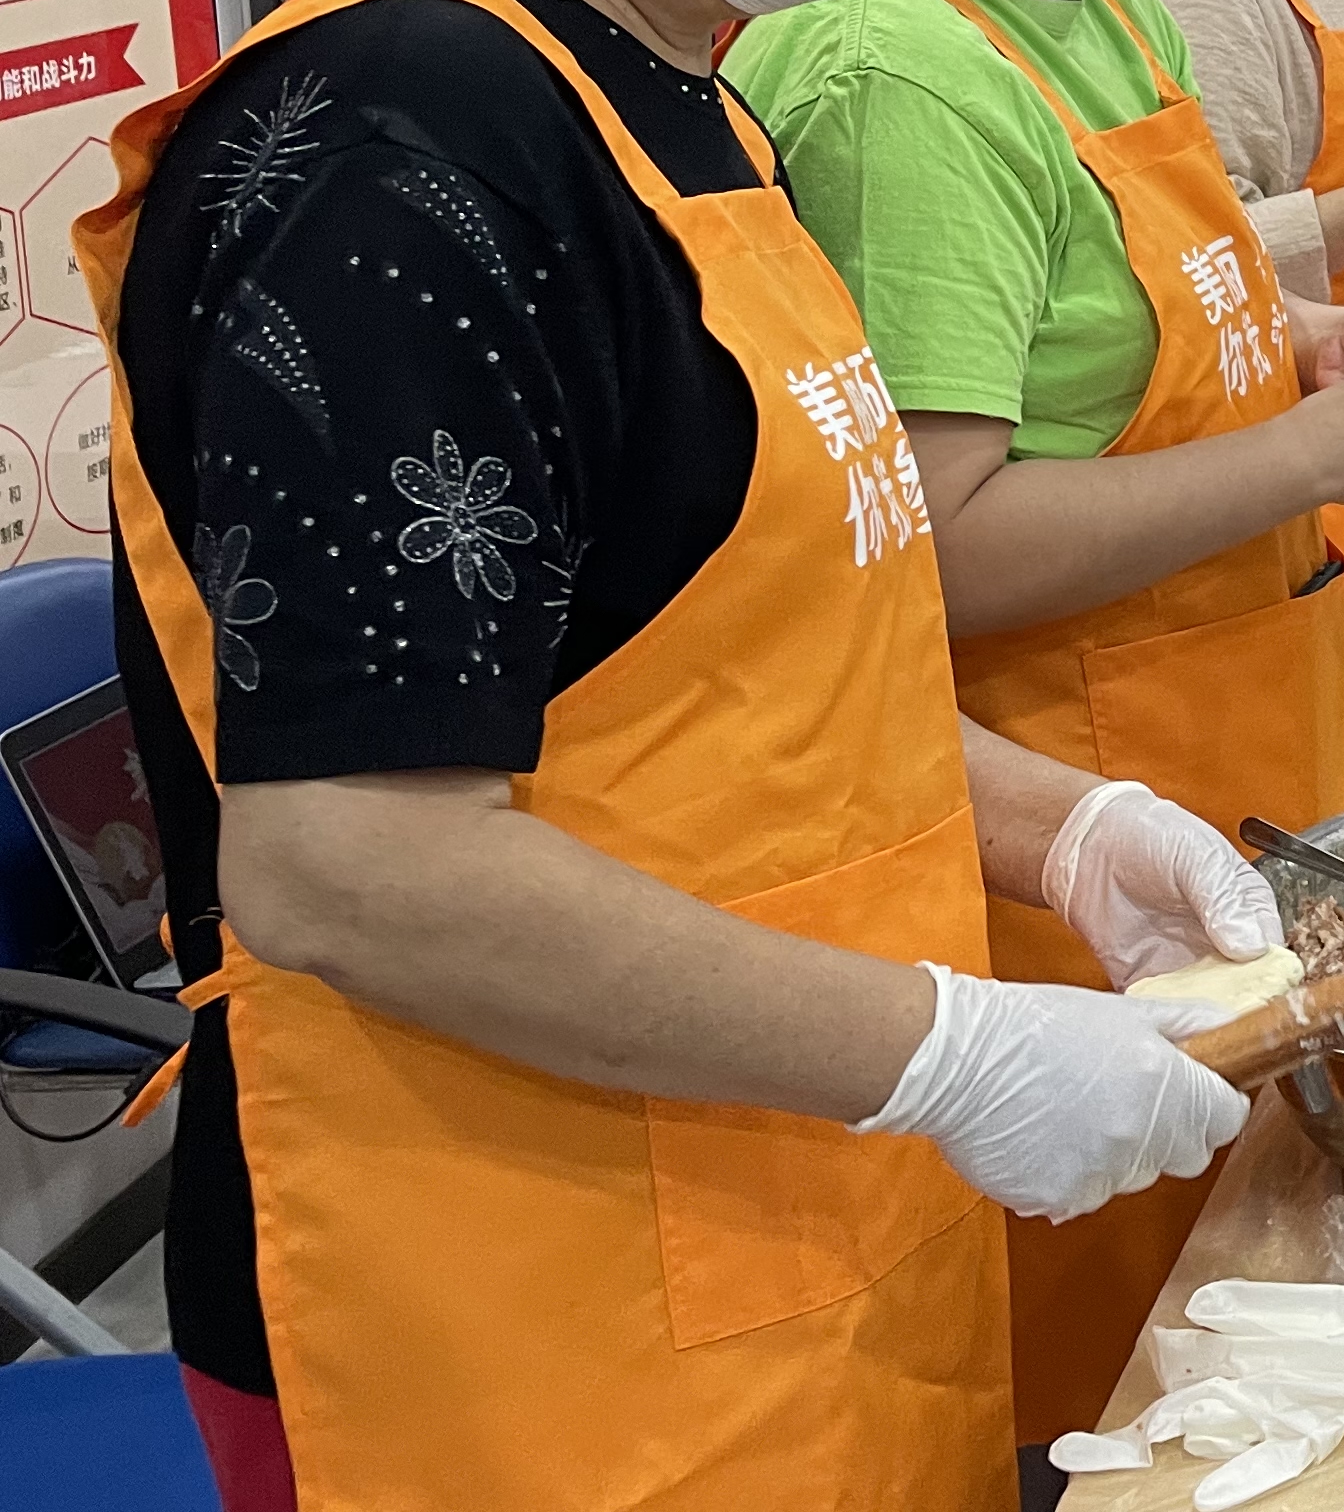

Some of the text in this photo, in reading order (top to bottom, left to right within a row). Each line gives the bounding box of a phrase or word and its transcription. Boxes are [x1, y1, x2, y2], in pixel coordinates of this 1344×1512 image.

[0, 51, 97, 101] 能和战斗力
